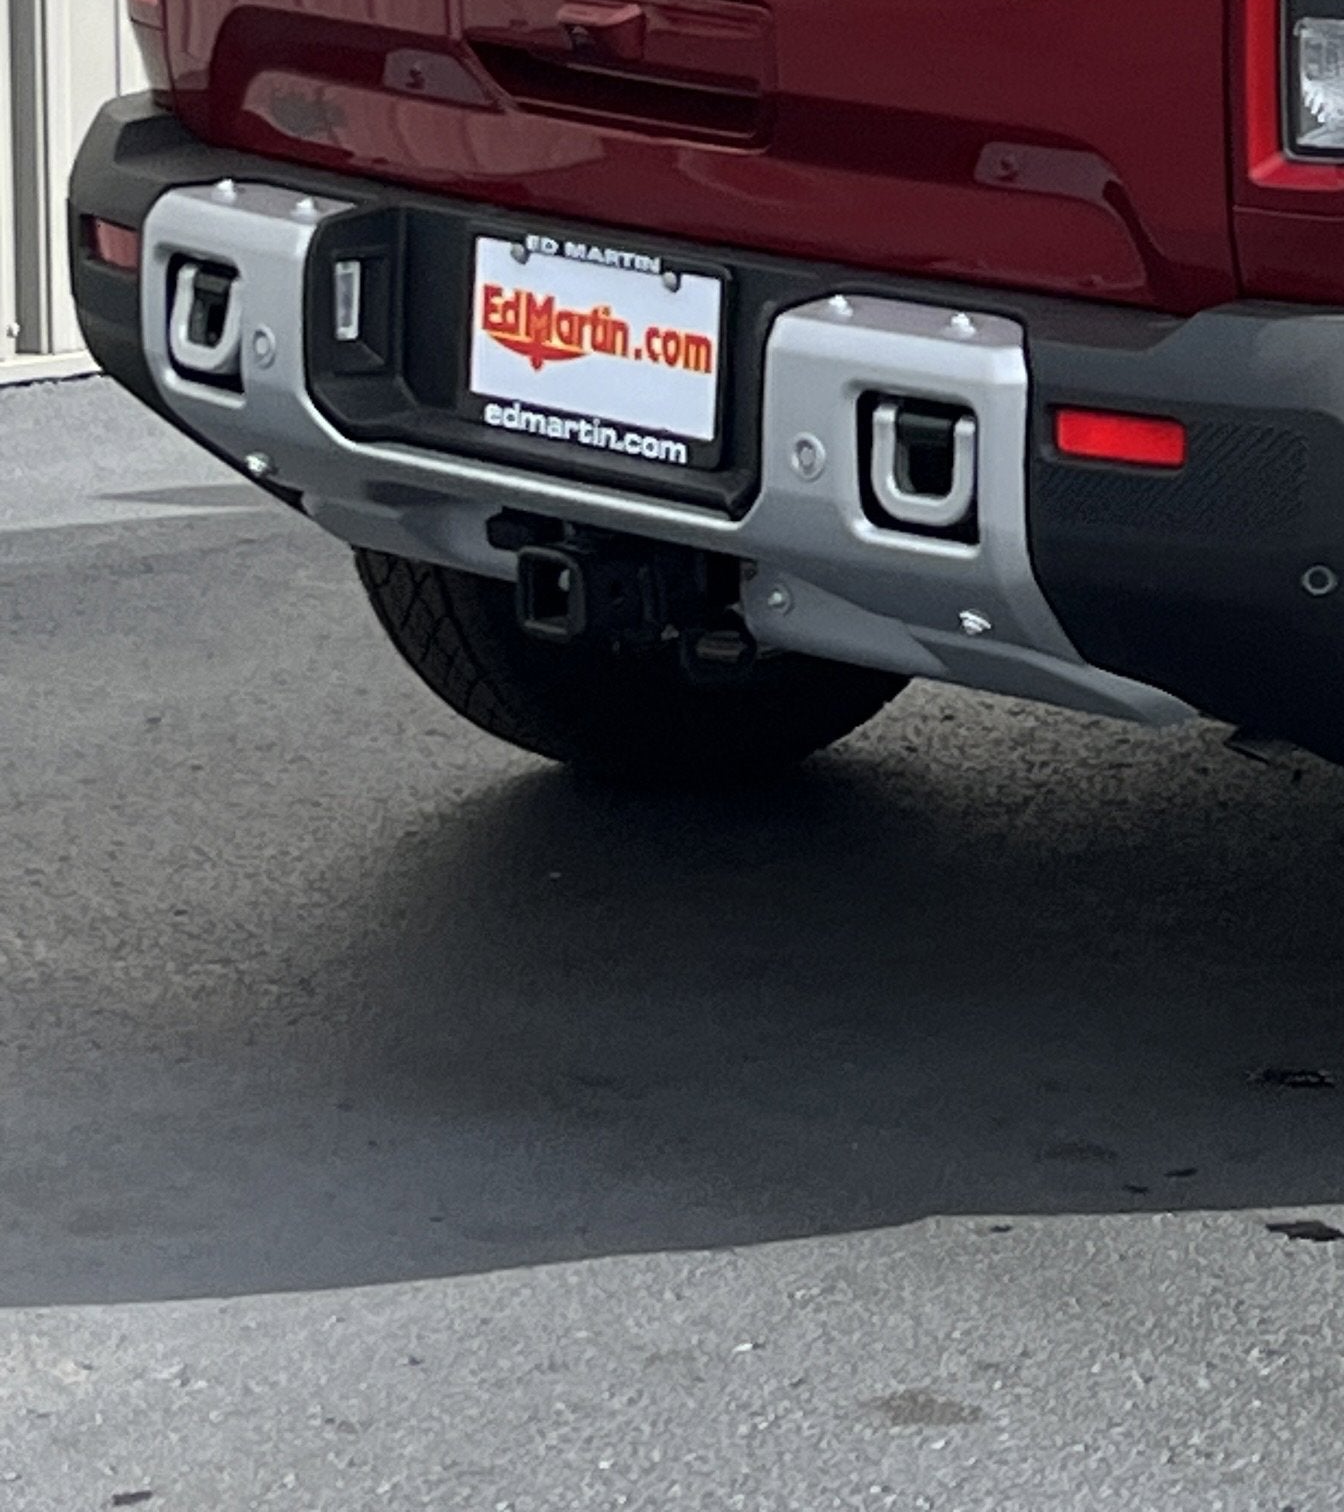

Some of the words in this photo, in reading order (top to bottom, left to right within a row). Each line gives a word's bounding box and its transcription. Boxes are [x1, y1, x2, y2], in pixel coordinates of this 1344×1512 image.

[526, 234, 559, 257] ED
[564, 241, 661, 274] MARTIN
[481, 283, 712, 374] EdMartin.com
[483, 400, 688, 465] edmartin.com
